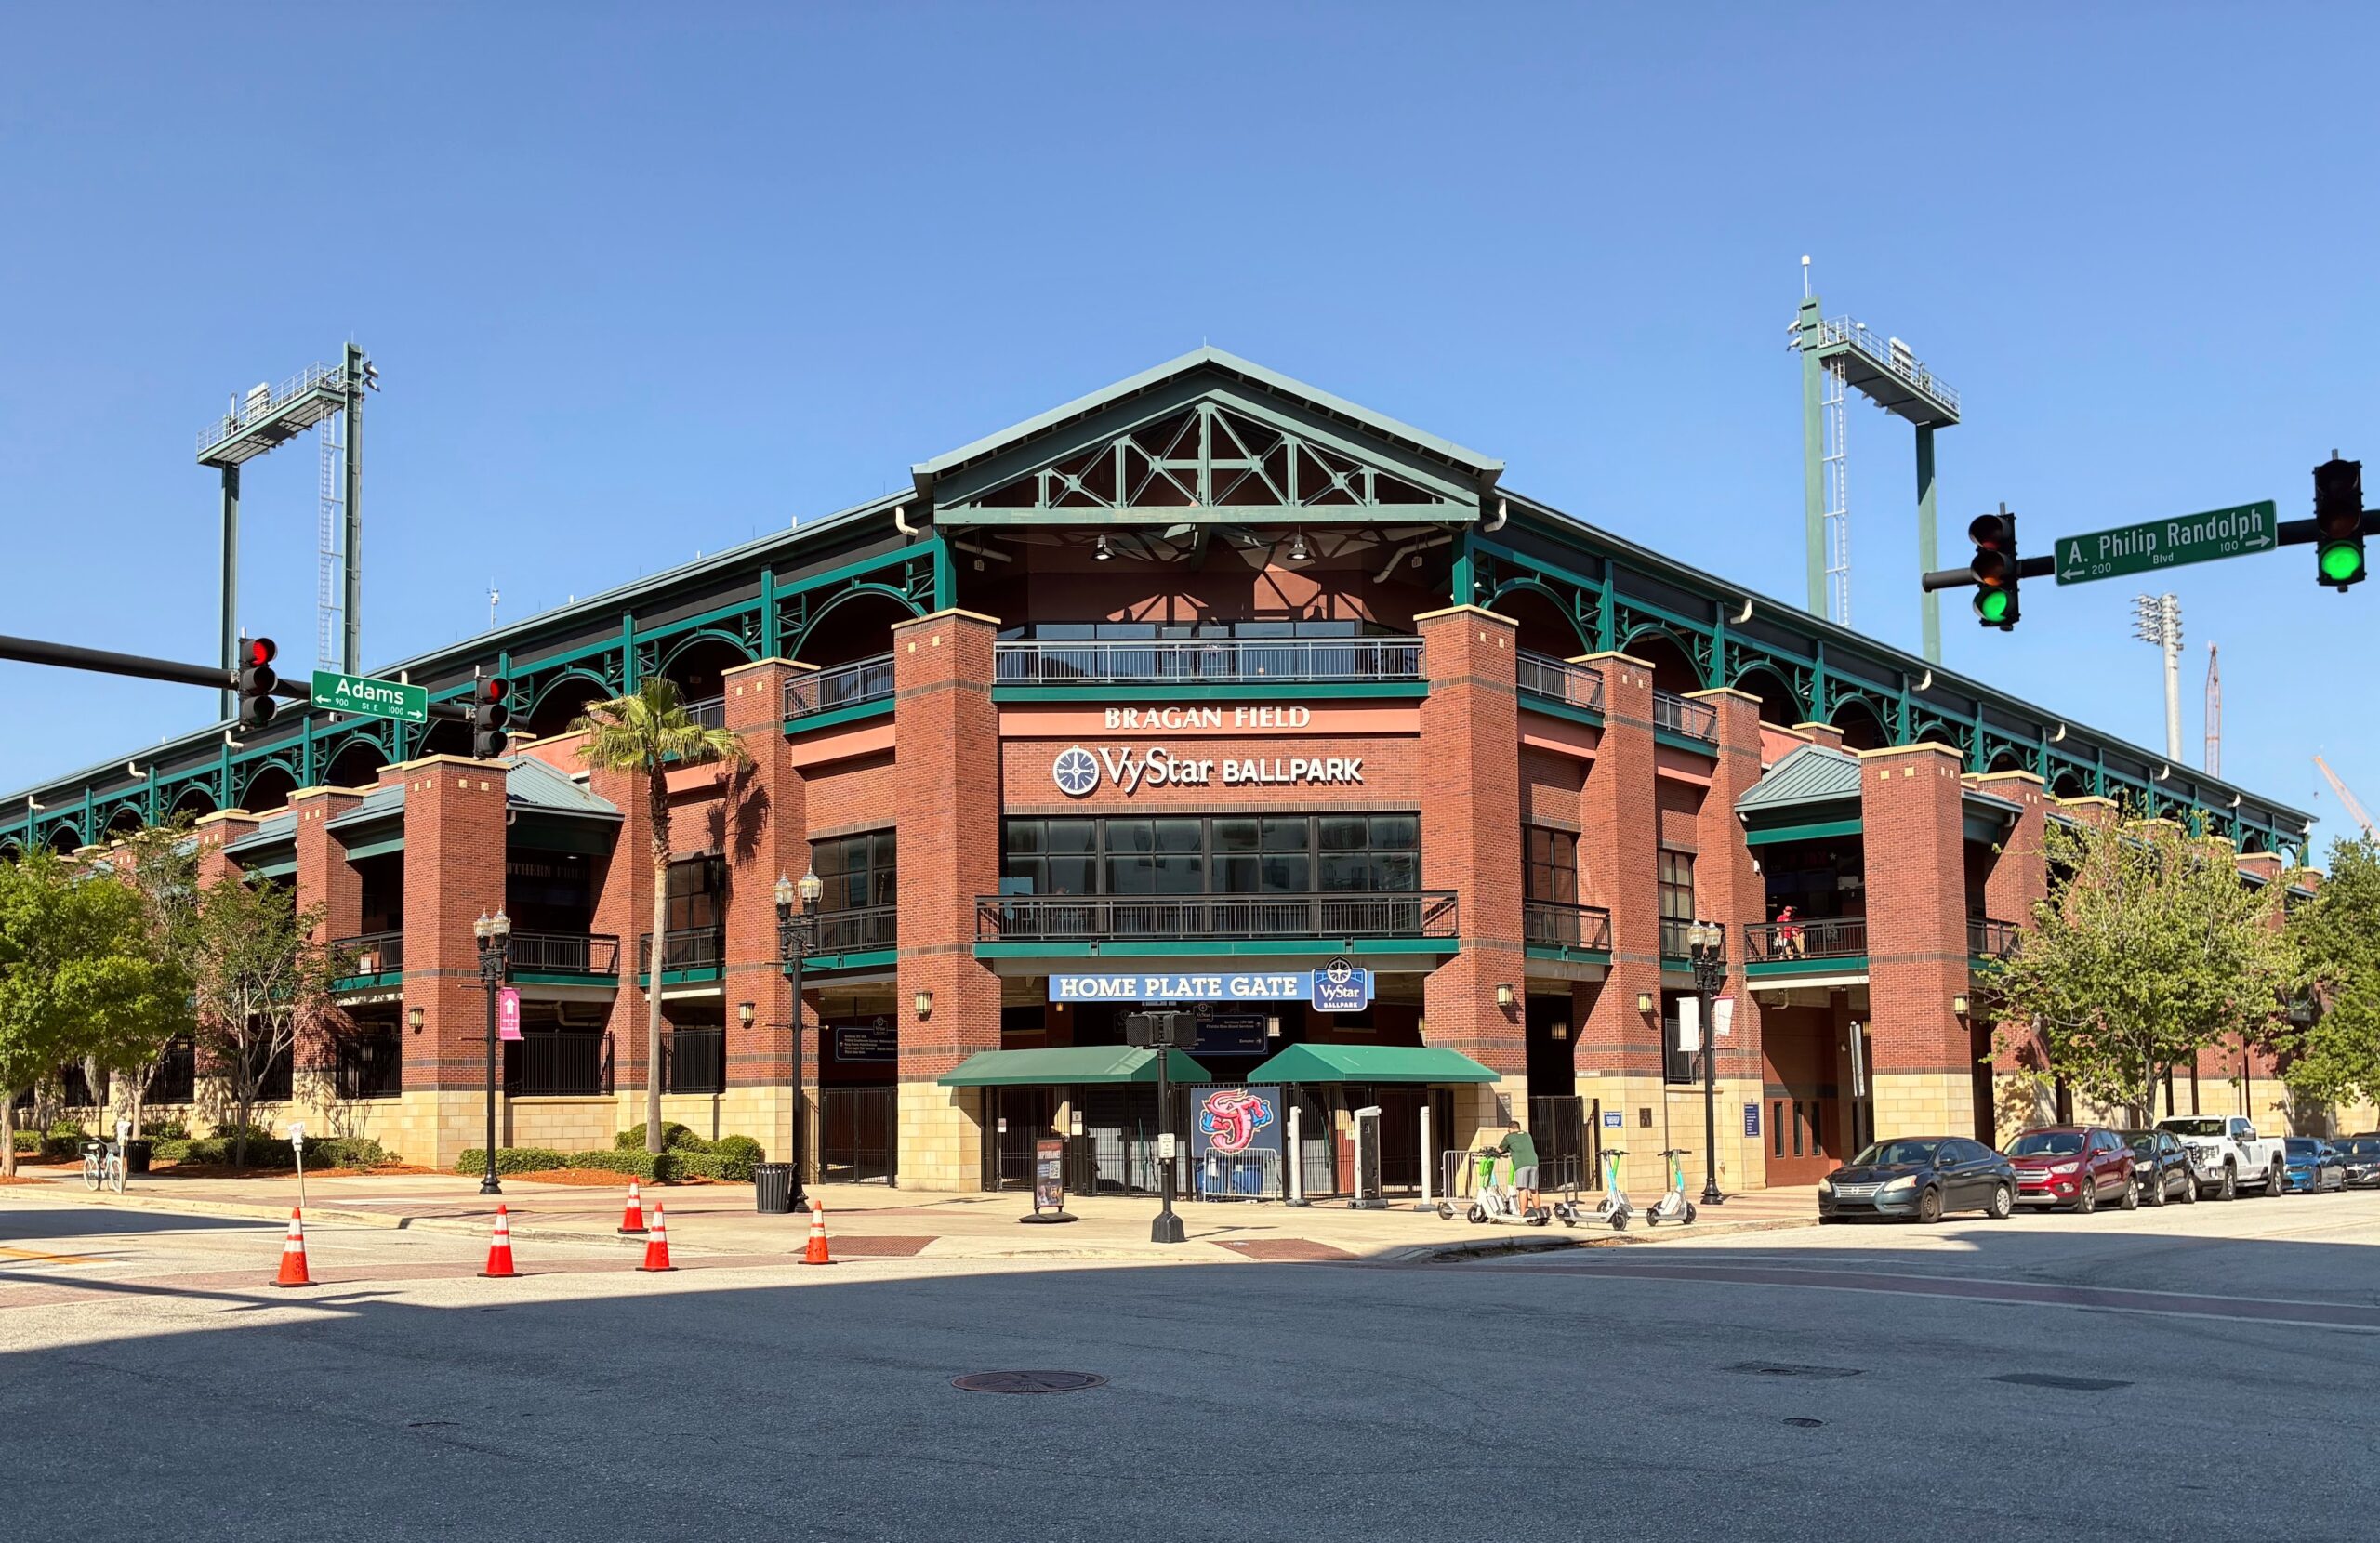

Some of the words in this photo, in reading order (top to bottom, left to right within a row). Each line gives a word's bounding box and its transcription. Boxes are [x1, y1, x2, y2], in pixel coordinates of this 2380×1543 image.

[2069, 540, 2089, 565] A.
[2099, 528, 2156, 557] Philip
[2167, 508, 2263, 547] Randolph
[2092, 562, 2111, 575] 200
[2153, 552, 2174, 564] Blvd
[2220, 540, 2239, 553] 100
[335, 678, 404, 705] Adams
[335, 697, 349, 707] 900
[362, 702, 369, 710] St
[388, 706, 403, 715] 1000
[1104, 706, 1222, 730] BRAGAN
[1235, 706, 1311, 729] FIELD
[1098, 746, 1214, 795] VyStar
[1223, 758, 1364, 783] BALLPARK
[1060, 978, 1137, 997] HOME
[1144, 977, 1222, 996] PLATE
[1230, 976, 1298, 996] GATE
[1319, 984, 1360, 1001] VyStar
